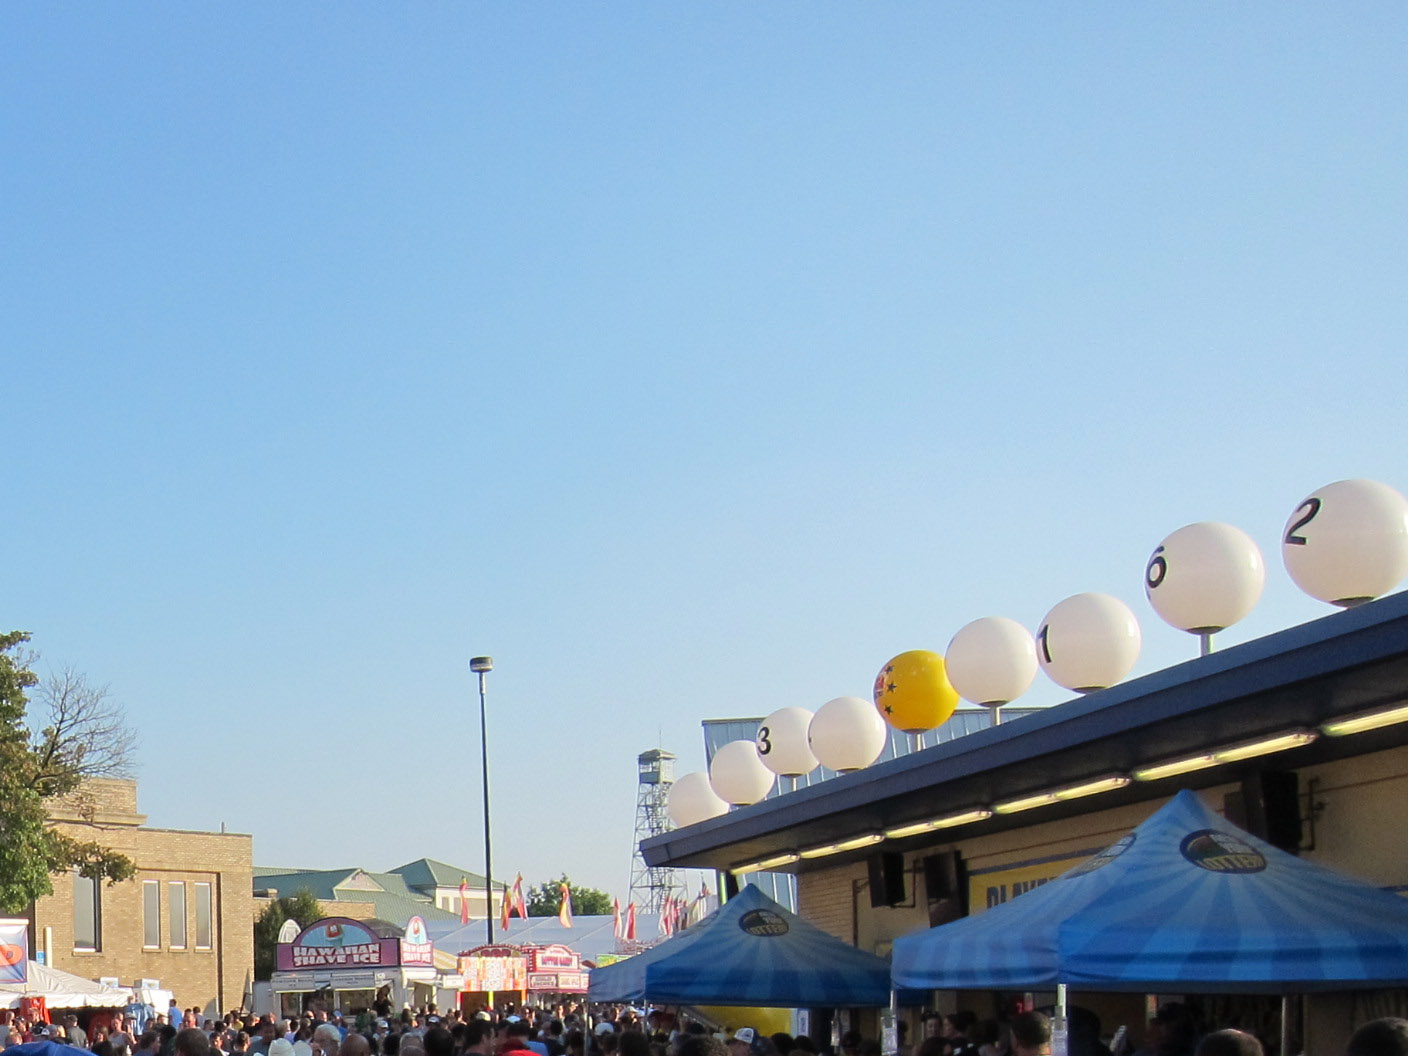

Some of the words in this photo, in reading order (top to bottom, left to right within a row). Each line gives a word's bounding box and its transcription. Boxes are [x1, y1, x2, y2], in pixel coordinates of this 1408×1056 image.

[1285, 498, 1321, 545] 2
[1146, 546, 1167, 588] 6
[1038, 624, 1052, 663] 1
[758, 727, 771, 755] 3
[293, 943, 380, 957] HAWAIIAN
[293, 954, 347, 967] SHAVE
[352, 953, 381, 963] ICE
